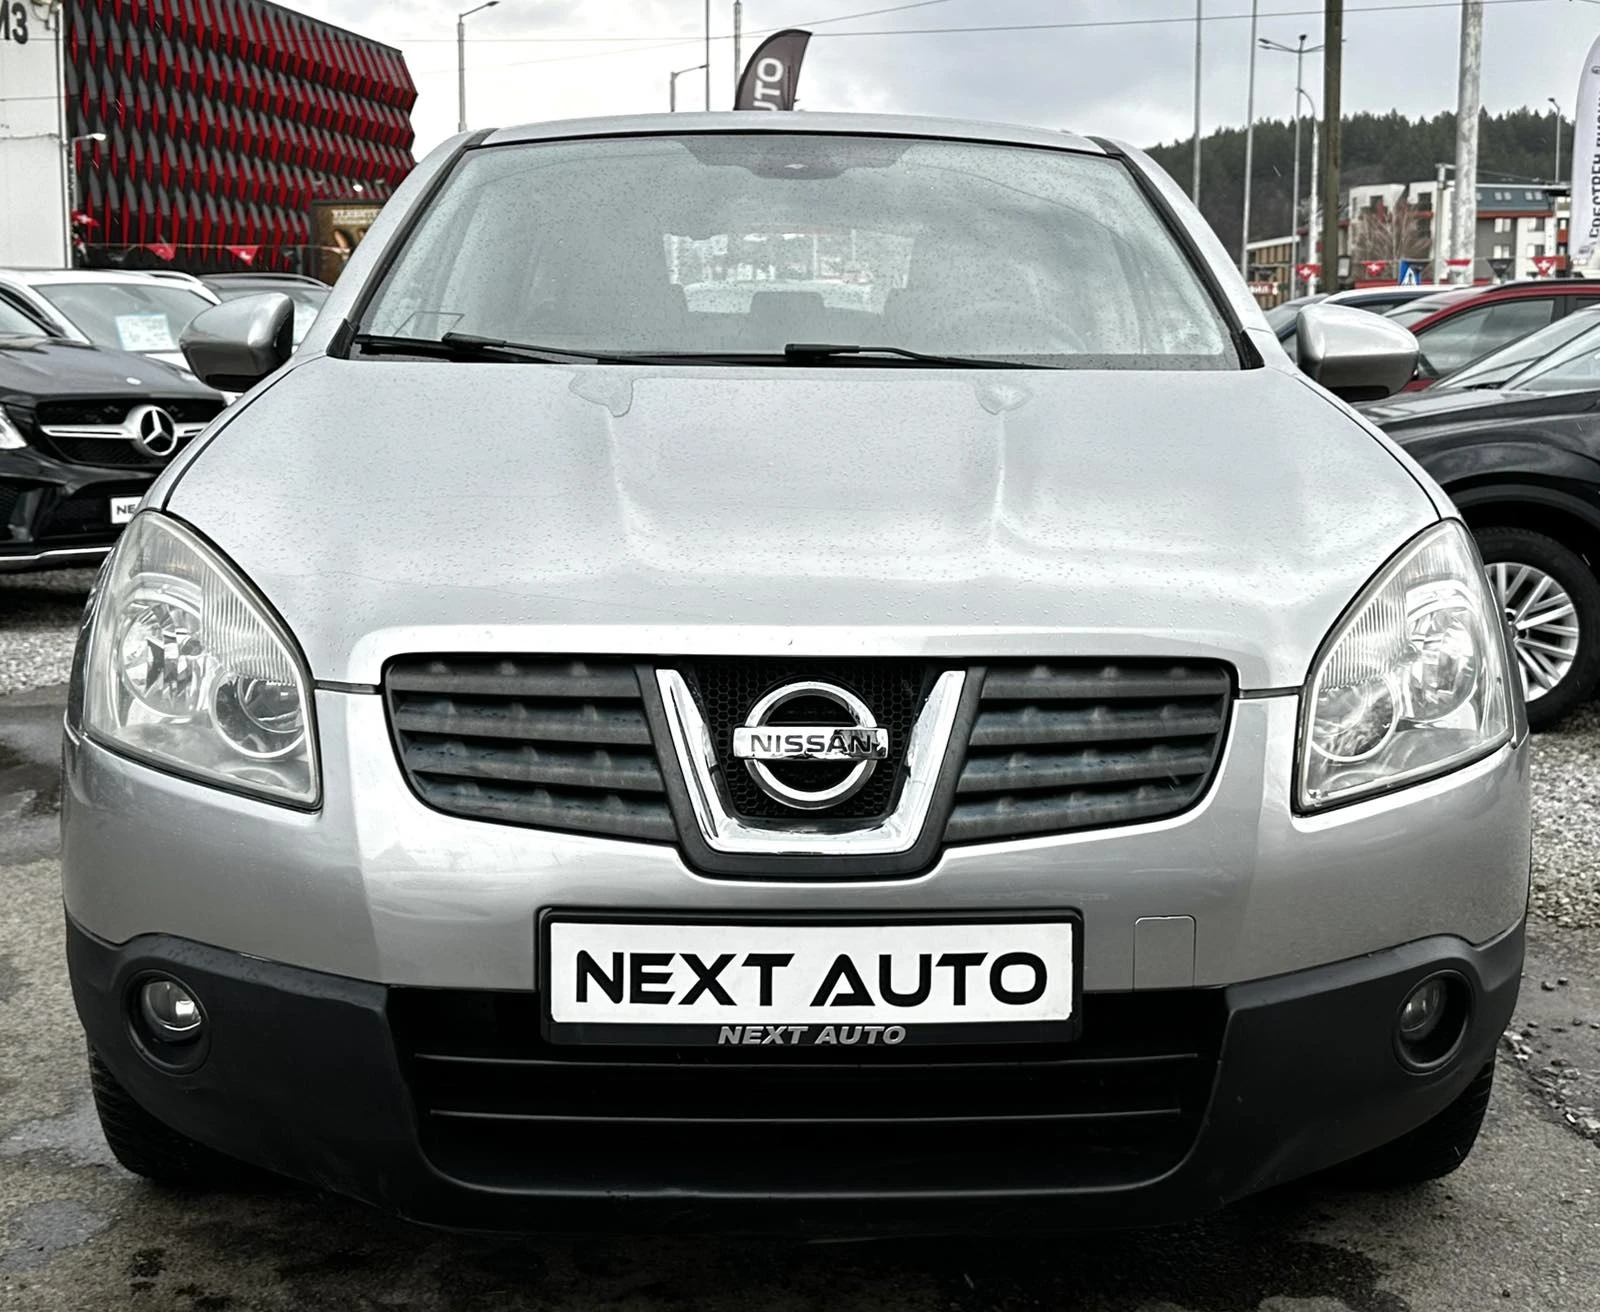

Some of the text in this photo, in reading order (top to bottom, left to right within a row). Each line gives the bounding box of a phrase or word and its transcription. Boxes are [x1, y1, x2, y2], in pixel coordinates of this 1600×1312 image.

[751, 734, 872, 754] NISSAN
[576, 950, 1048, 1008] NEXT AUTO
[717, 1024, 907, 1046] NEXT AUTO
